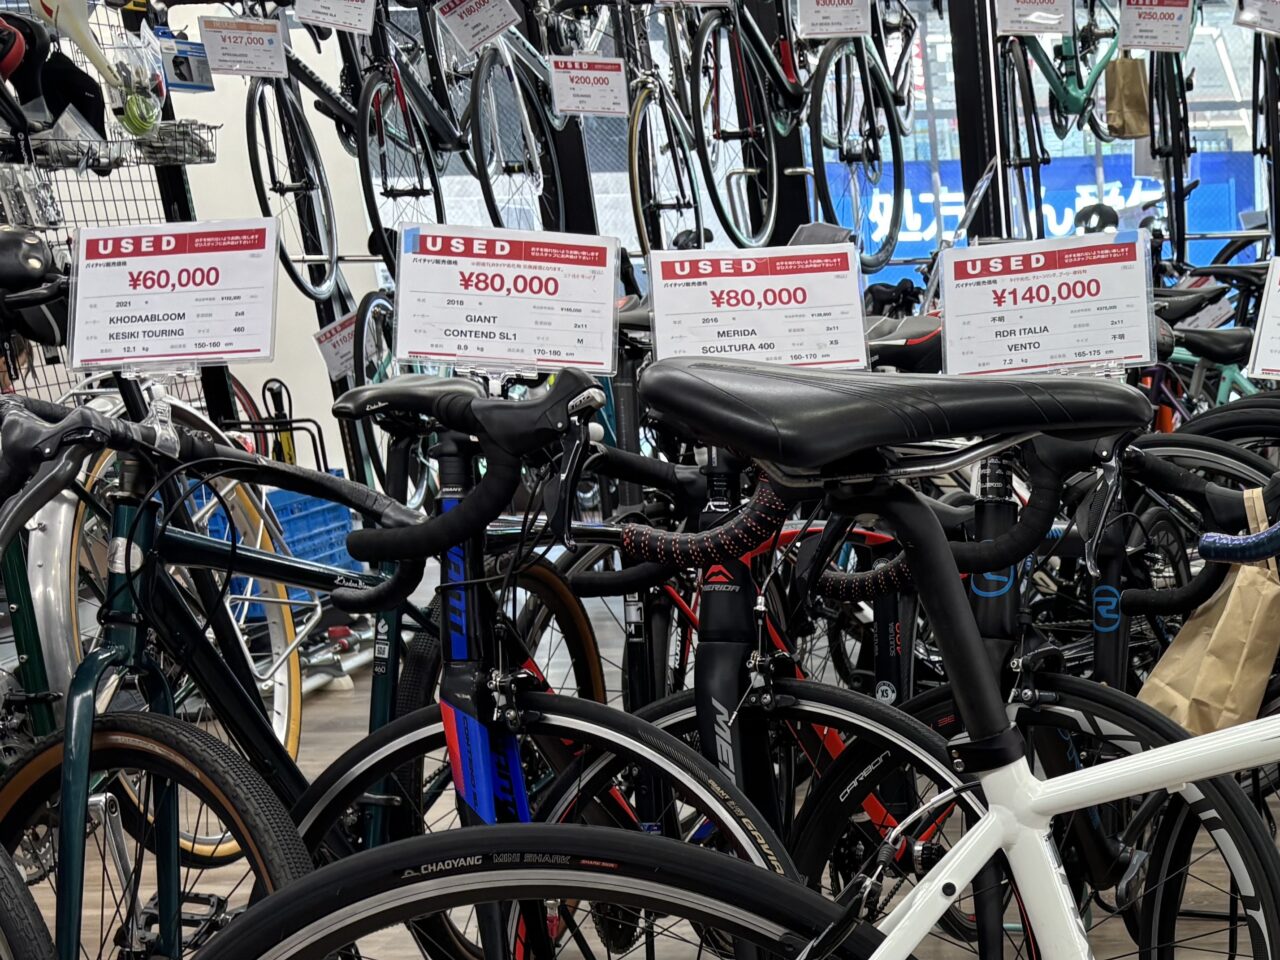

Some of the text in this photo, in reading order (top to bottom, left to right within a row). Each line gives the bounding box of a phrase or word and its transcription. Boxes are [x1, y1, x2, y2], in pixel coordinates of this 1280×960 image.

[221, 35, 264, 46] ¥127,000
[569, 75, 609, 86] ¥200,000
[98, 235, 176, 255] USED
[426, 235, 511, 255] USED
[674, 259, 757, 276] USED
[966, 253, 1046, 275] USED
[129, 267, 220, 292] ¥60,000
[459, 271, 559, 296] ¥80,000
[710, 287, 807, 310] ¥80,000
[992, 278, 1101, 307] ¥140,000
[115, 300, 132, 308] 2021
[109, 312, 186, 325] KHODAABLOOM
[465, 314, 498, 324] GIANT
[990, 315, 1005, 323] 不明
[109, 329, 185, 341] KESIKI TOURING
[444, 329, 517, 341] CONTEND SL1
[717, 328, 757, 338] MERIDA
[995, 325, 1050, 339] RDR ITALIA
[1111, 333, 1125, 341] 不明
[194, 341, 221, 349] 150-160
[829, 338, 839, 346] XS
[1007, 341, 1041, 352] VENTO
[533, 349, 561, 357] 170-180
[701, 342, 775, 355] SCULTURA 400
[1074, 350, 1101, 358] 165-175
[790, 353, 817, 361] 160-170
[627, 624, 635, 635] M
[880, 689, 889, 698] XS
[839, 750, 891, 802] CARBON
[741, 817, 786, 875] GAVIA
[420, 853, 571, 875] CHAOYANG MINI SHARK
